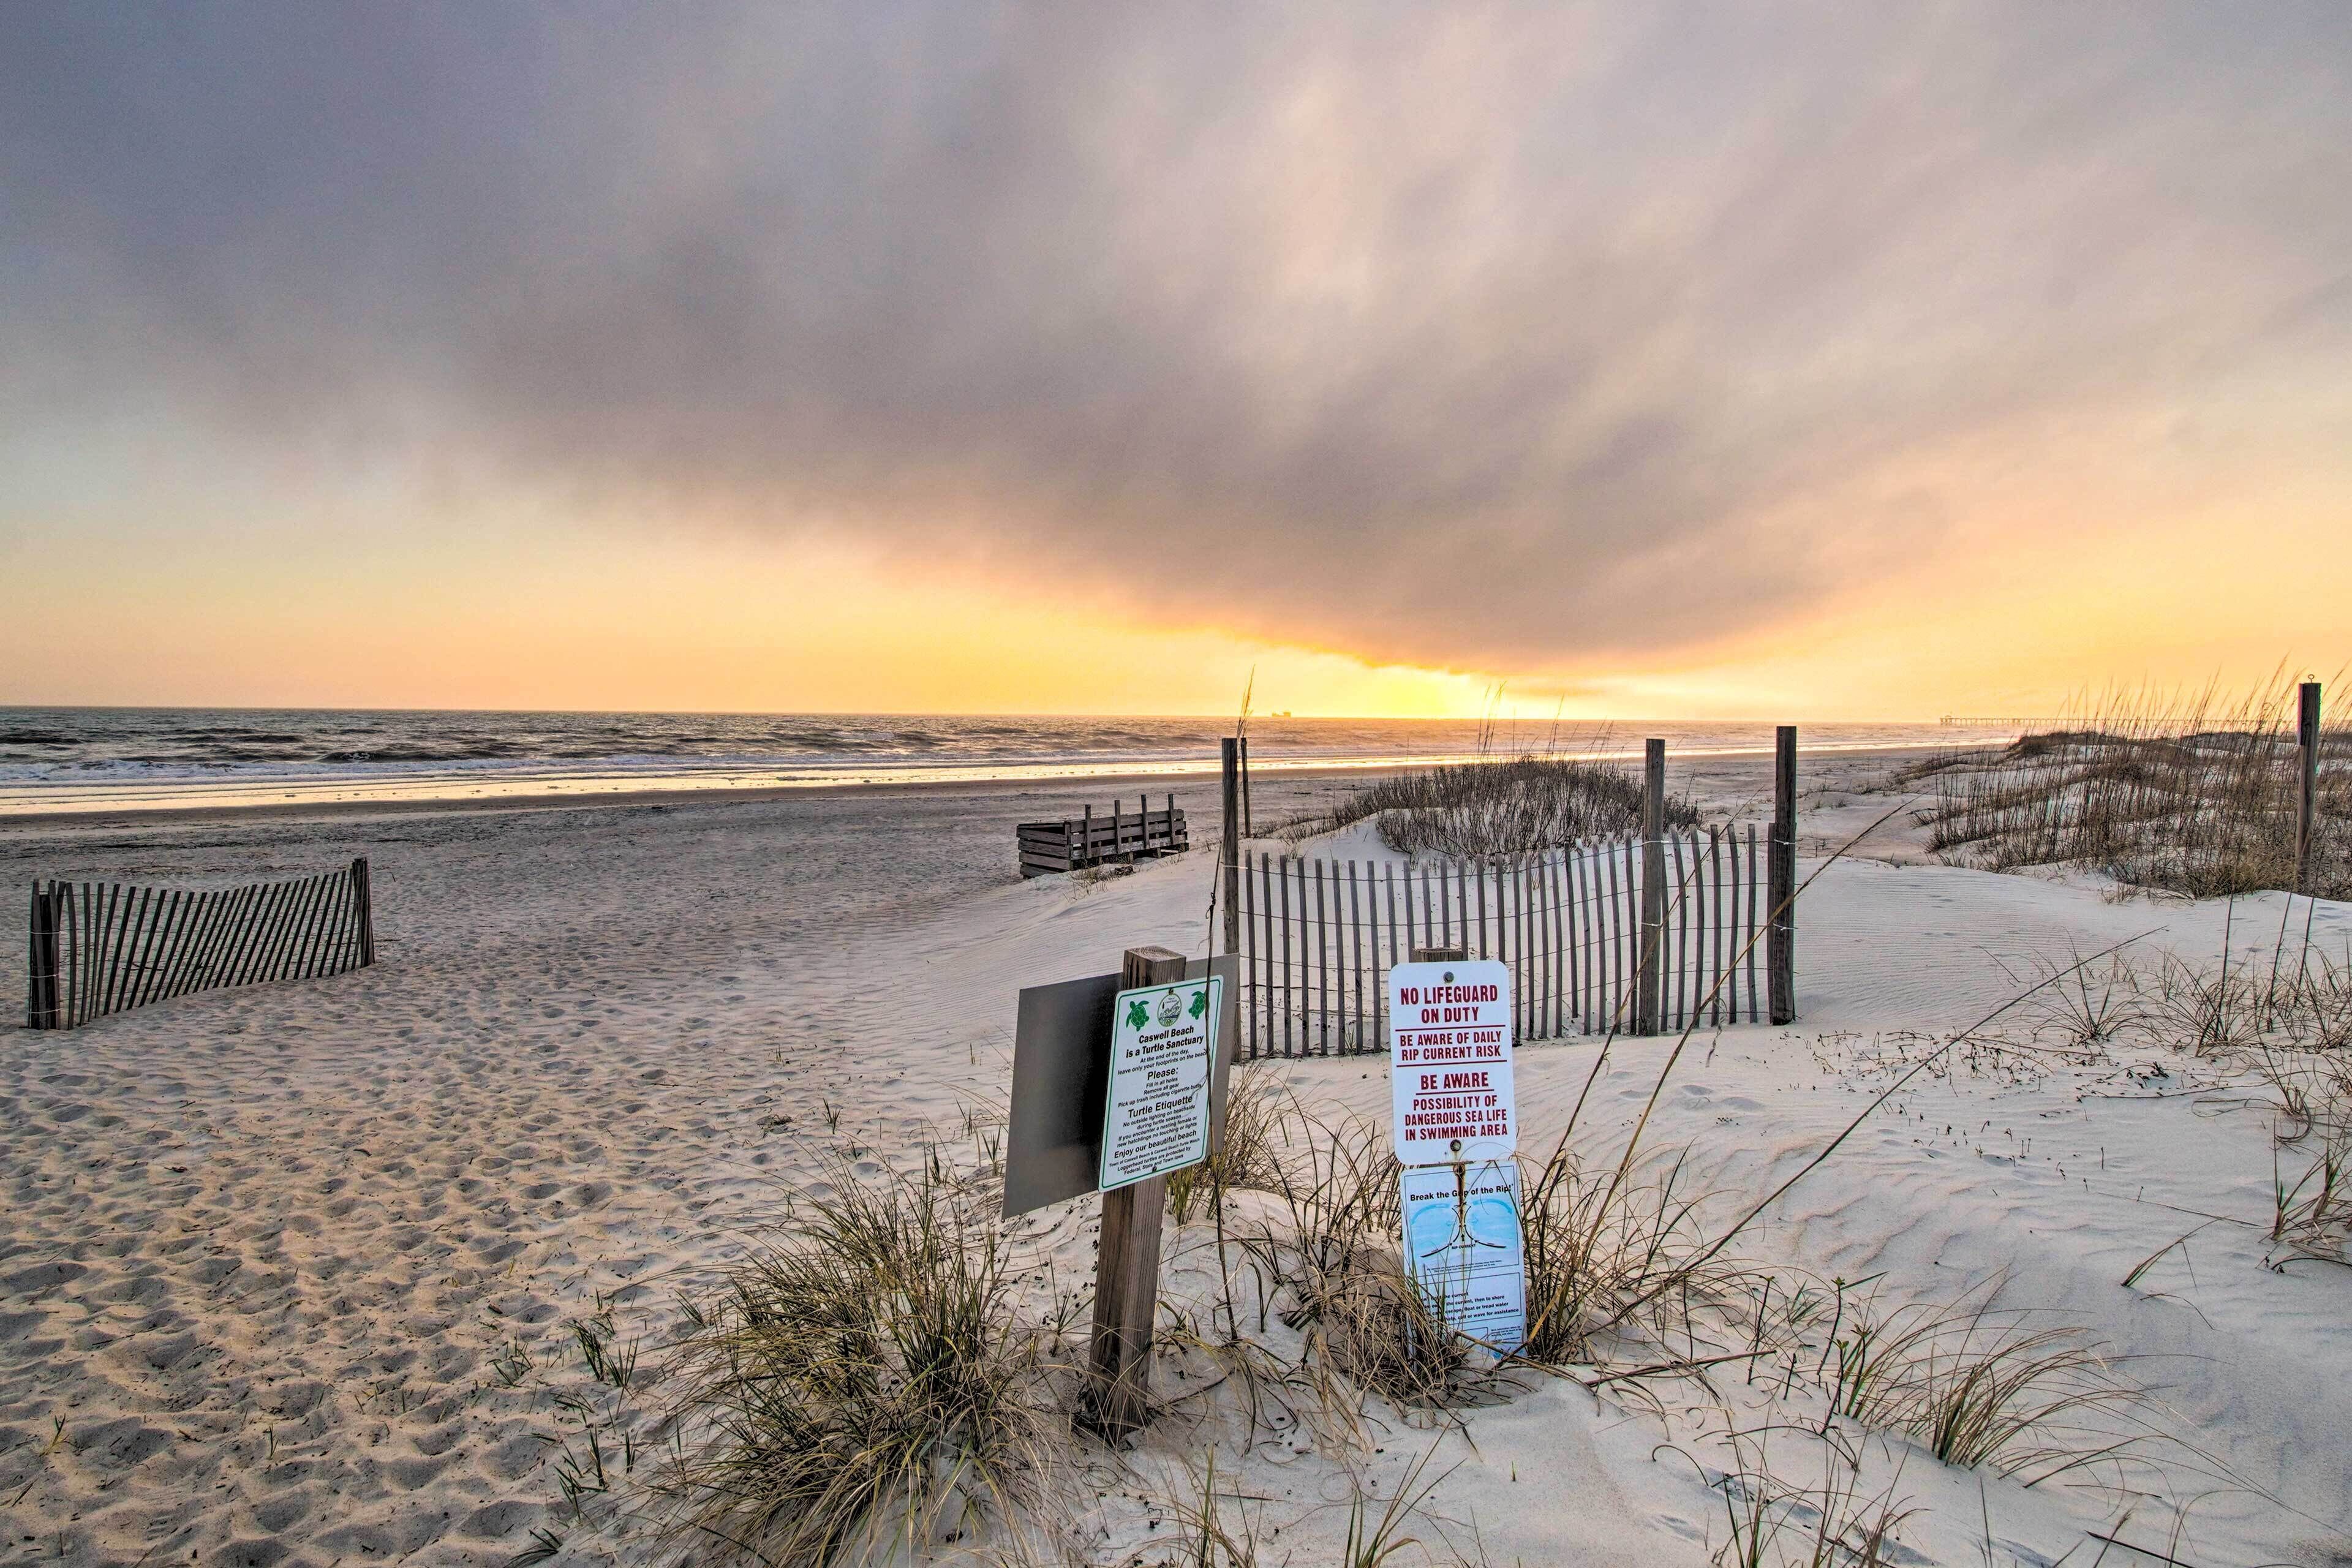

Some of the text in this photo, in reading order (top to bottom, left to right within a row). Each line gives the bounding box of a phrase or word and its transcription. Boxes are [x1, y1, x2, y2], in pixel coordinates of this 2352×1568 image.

[1400, 985, 1498, 1005] NO LIFEGUARD
[1422, 1007, 1479, 1023] ON DUTY
[1139, 1025, 1194, 1044] Caswell Beach
[1400, 1031, 1501, 1047] BE AWARE OF DAILY
[1126, 1049, 1133, 1058] is
[1142, 1043, 1164, 1054] Turtle
[1166, 1035, 1204, 1049] Sanctuary
[1402, 1045, 1501, 1061] RIP CURRENT RISK
[1156, 1058, 1178, 1066] footprints
[1147, 1068, 1178, 1080] Please:
[1421, 1072, 1489, 1090] BE AWARE
[1149, 1091, 1170, 1099] including
[1414, 1095, 1497, 1110] POSSIBILITY OF
[1128, 1096, 1193, 1118] Turtle Etiquette
[1131, 1116, 1148, 1125] outside
[1174, 1104, 1195, 1114] beachside
[1405, 1109, 1507, 1126] DANGEROUS SEA LIFE
[1133, 1127, 1155, 1137] encounter
[1160, 1122, 1177, 1131] nesting
[1406, 1124, 1507, 1140] IN SWIMMING AREA
[1114, 1148, 1133, 1158] Enjoy
[1148, 1135, 1176, 1148] beautiful
[1178, 1130, 1196, 1140] beach
[1128, 1135, 1152, 1145] hatchlings
[1117, 1160, 1143, 1171] Loggerhead
[1166, 1147, 1185, 1157] protected
